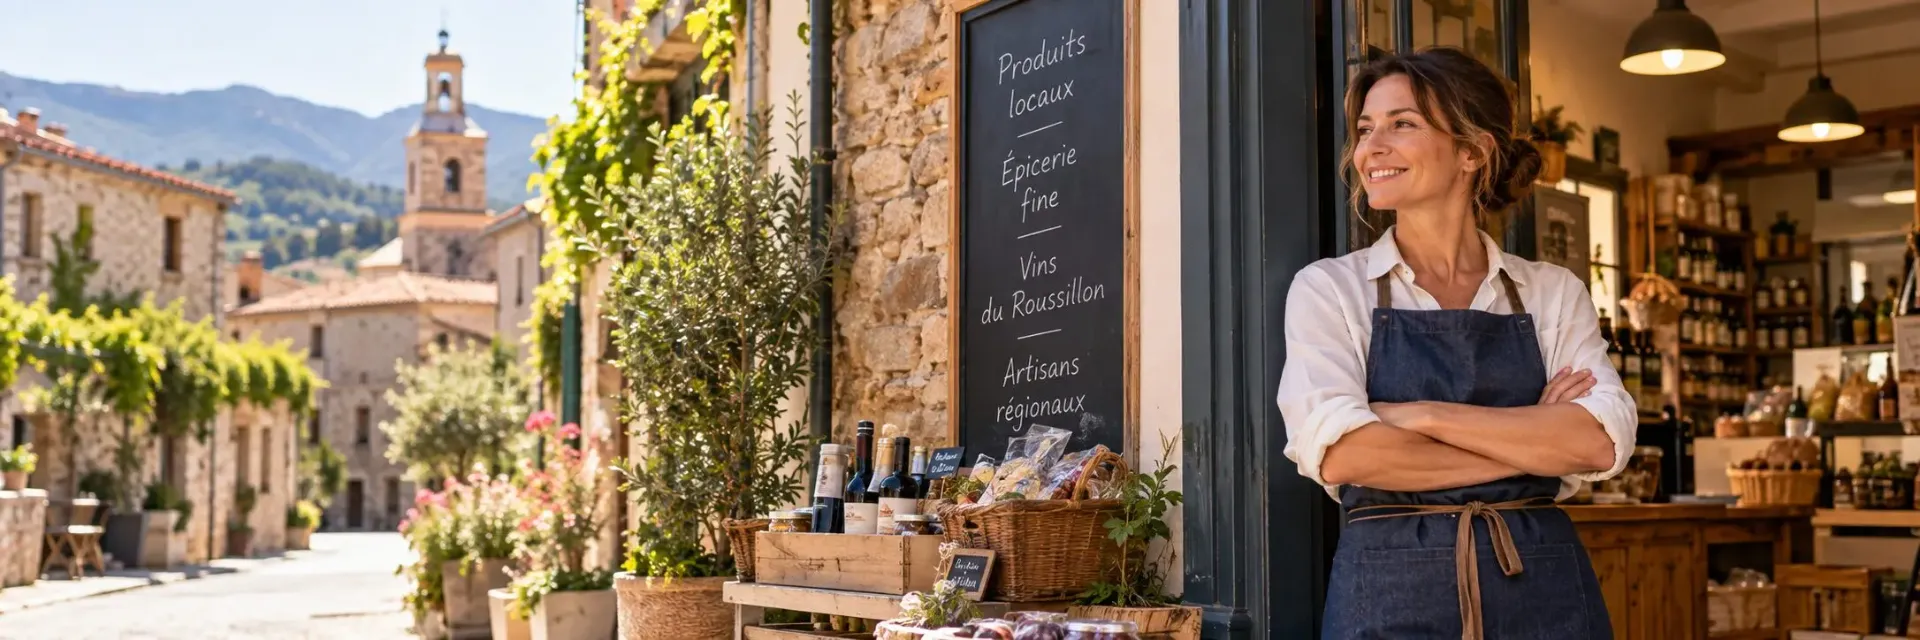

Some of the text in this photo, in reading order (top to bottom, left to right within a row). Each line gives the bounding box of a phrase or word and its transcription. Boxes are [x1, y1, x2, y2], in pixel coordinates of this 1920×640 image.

[998, 28, 1086, 85] Produits
[1009, 79, 1074, 118] locaux
[1001, 144, 1077, 193] Épicerie
[1021, 187, 1060, 223] fine
[1020, 251, 1057, 281] Vins
[981, 276, 1105, 325] du Roussillon
[1003, 354, 1080, 388] Artisans
[996, 394, 1086, 432] régionaux
